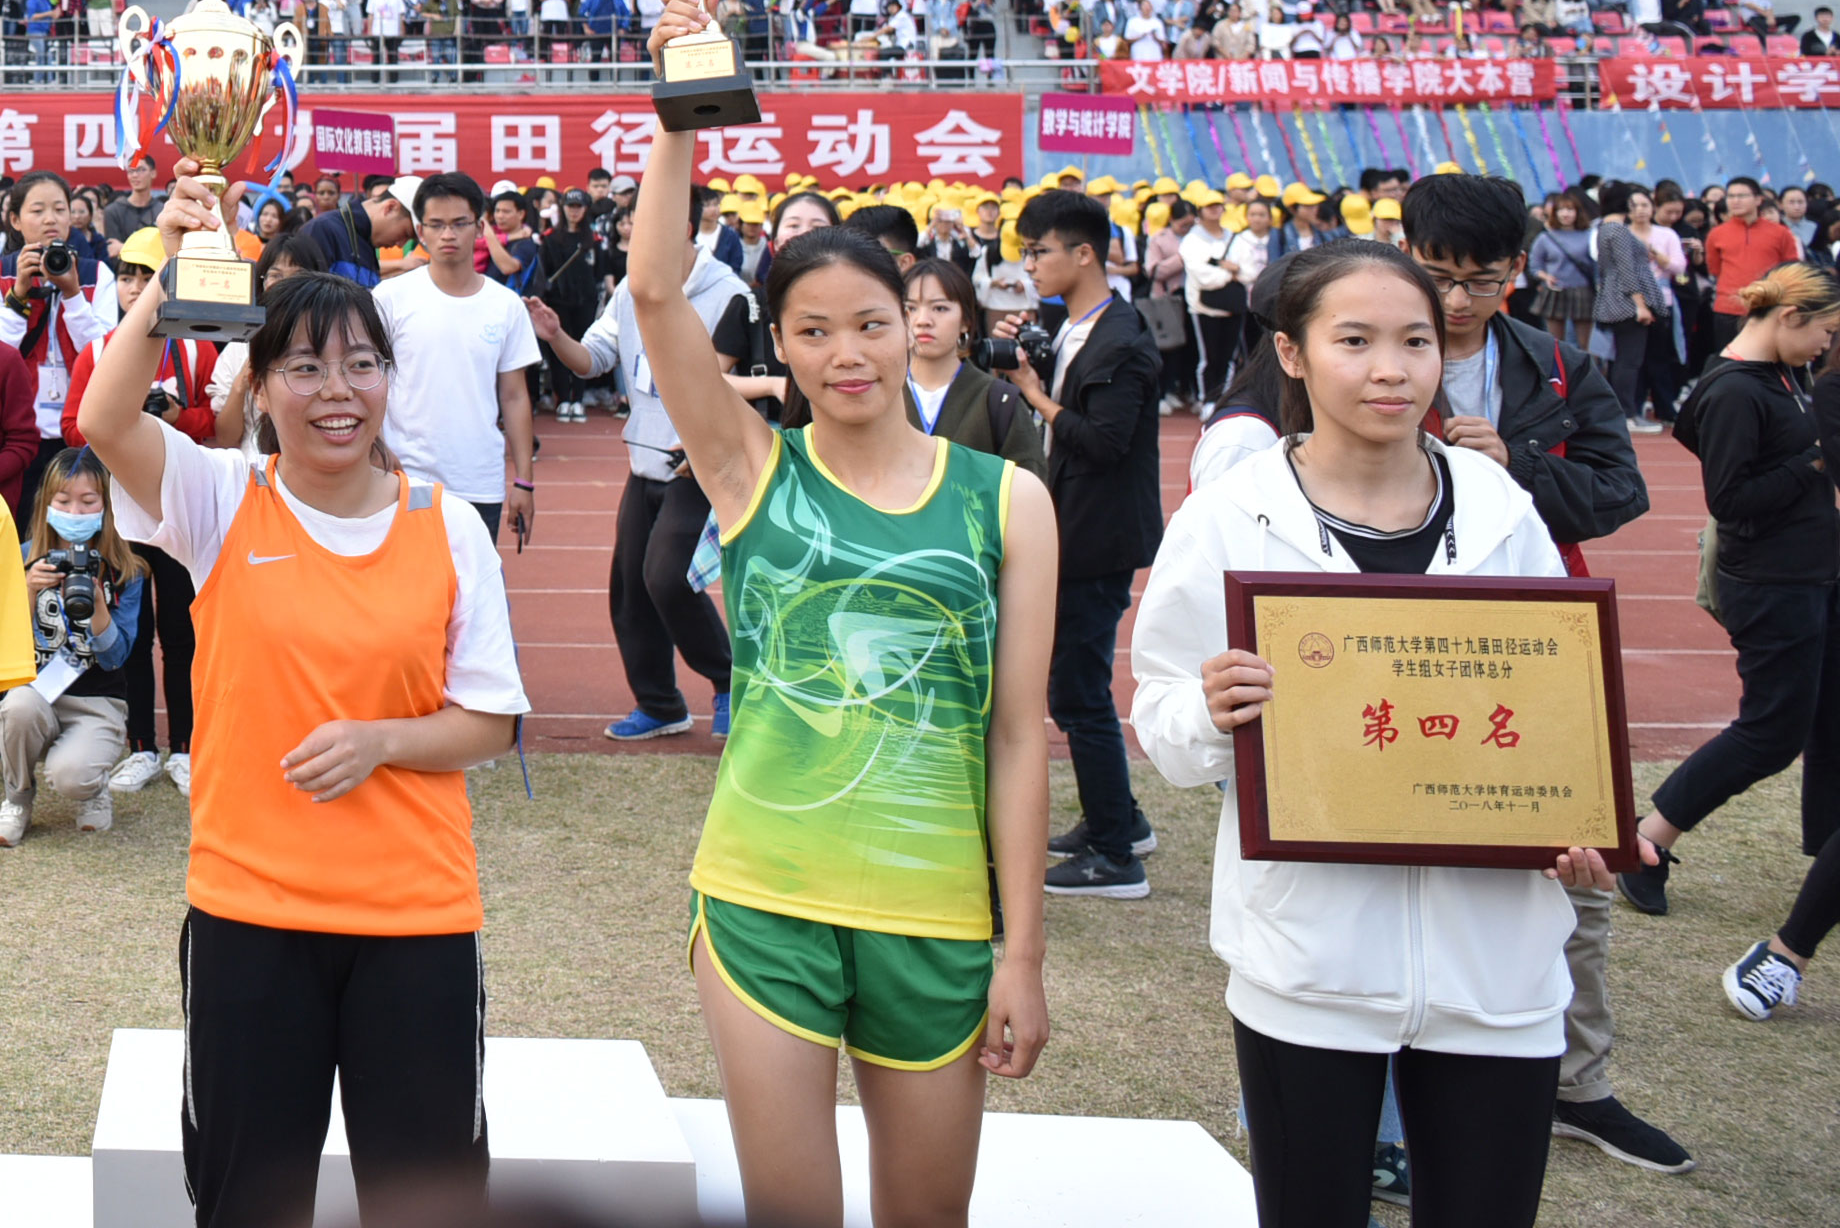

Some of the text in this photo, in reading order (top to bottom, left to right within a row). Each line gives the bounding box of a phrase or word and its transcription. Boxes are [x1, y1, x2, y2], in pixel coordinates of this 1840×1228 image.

[1125, 62, 1535, 97] 文学院/新闻与传播学院大本营
[315, 122, 393, 159] 国际文化教育学院
[1041, 107, 1132, 141] 数学与统计学院
[1342, 635, 1559, 656] 广西师范大学第四十九届田径运动会
[1391, 659, 1513, 679] 学生组女子团体总分
[1361, 698, 1521, 752] 第四名
[1412, 783, 1573, 798] 广西师范大学体育运动委员会
